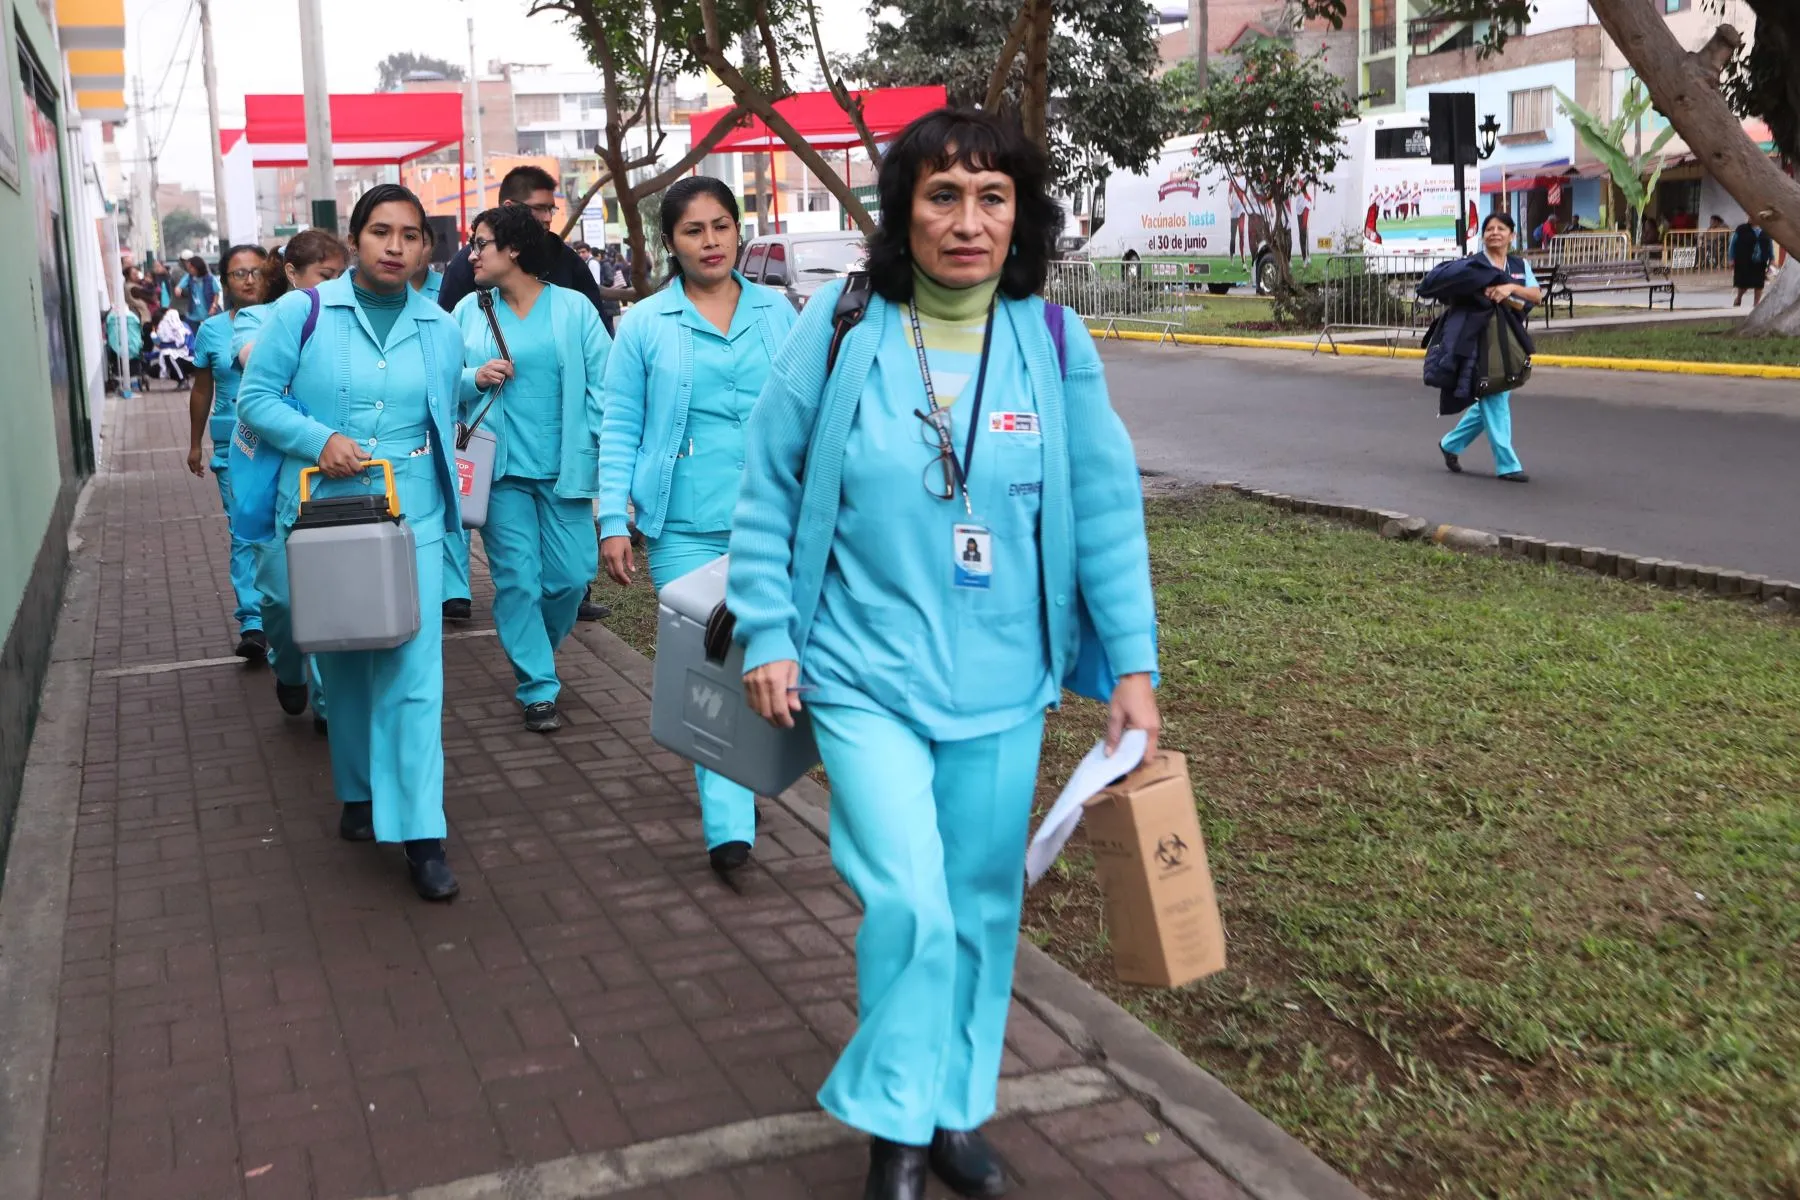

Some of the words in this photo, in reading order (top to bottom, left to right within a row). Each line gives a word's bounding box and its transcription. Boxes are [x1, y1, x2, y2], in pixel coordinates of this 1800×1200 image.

[1141, 212, 1186, 228] Vacúnalos
[1188, 212, 1215, 227] hasta
[1148, 237, 1156, 250] el
[1157, 235, 1170, 250] 30
[1171, 234, 1183, 249] de
[1184, 234, 1207, 252] junio
[237, 422, 259, 446] dos
